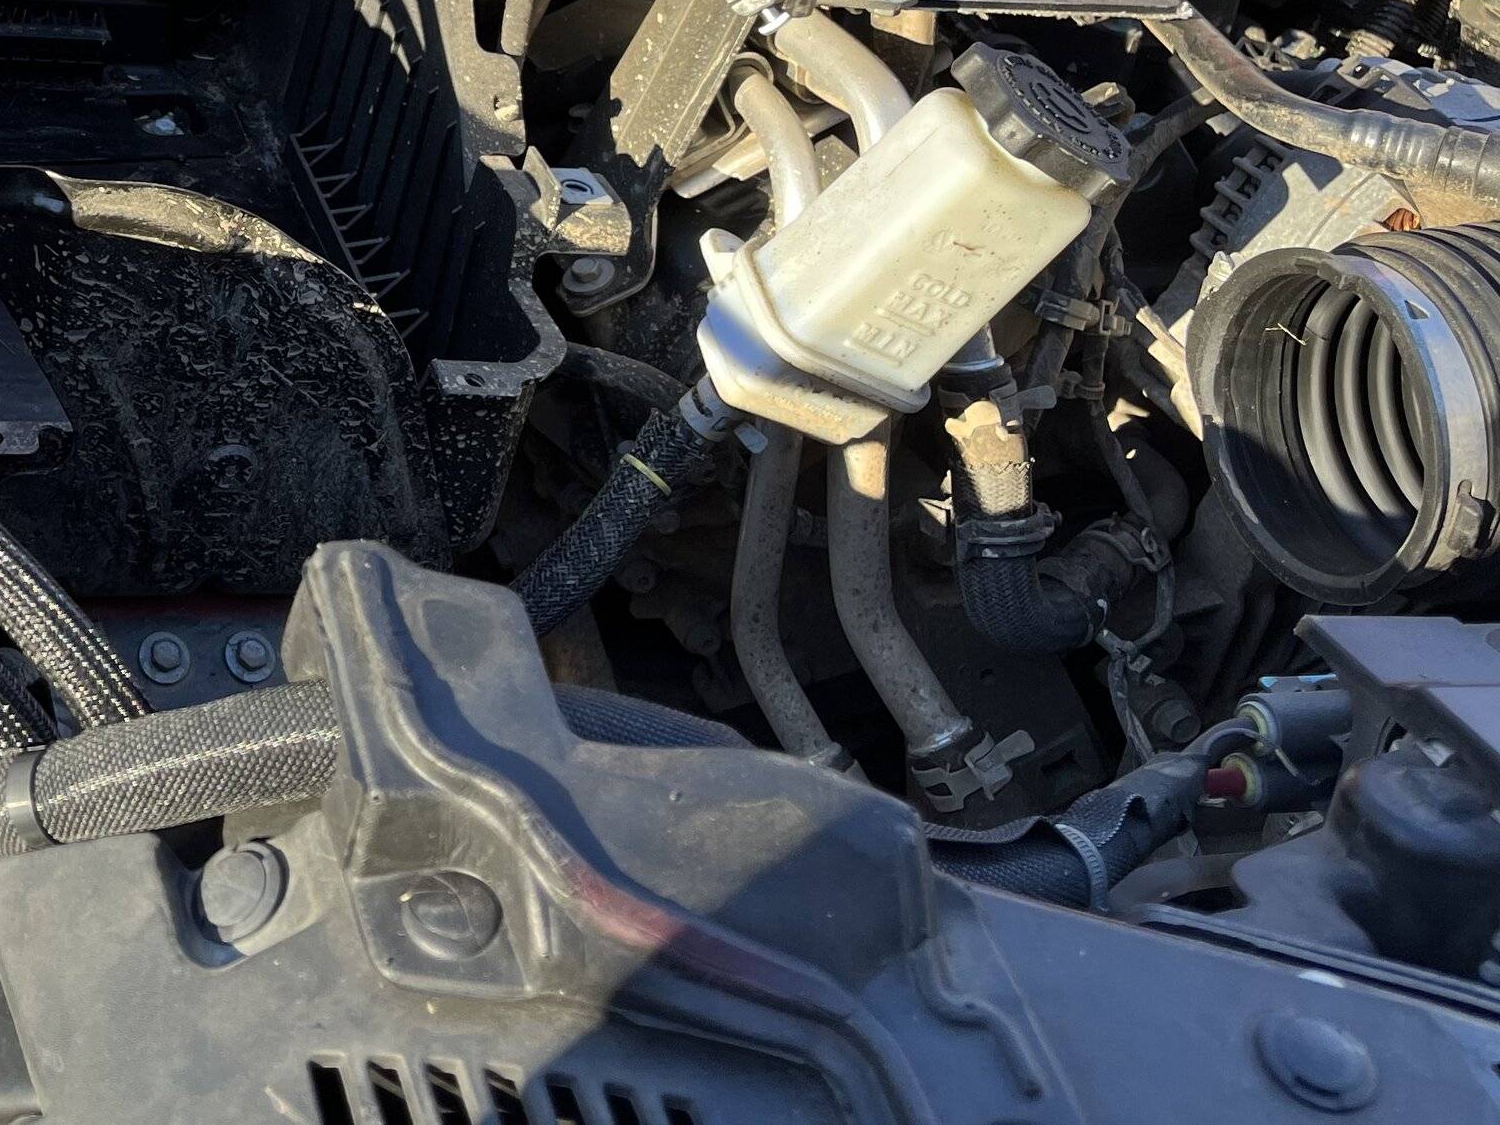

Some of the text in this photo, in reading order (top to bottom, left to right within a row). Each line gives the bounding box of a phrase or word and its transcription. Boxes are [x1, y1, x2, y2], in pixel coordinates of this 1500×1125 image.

[884, 290, 953, 329] MAX
[911, 273, 972, 309] COLD
[851, 321, 920, 361] MIN
